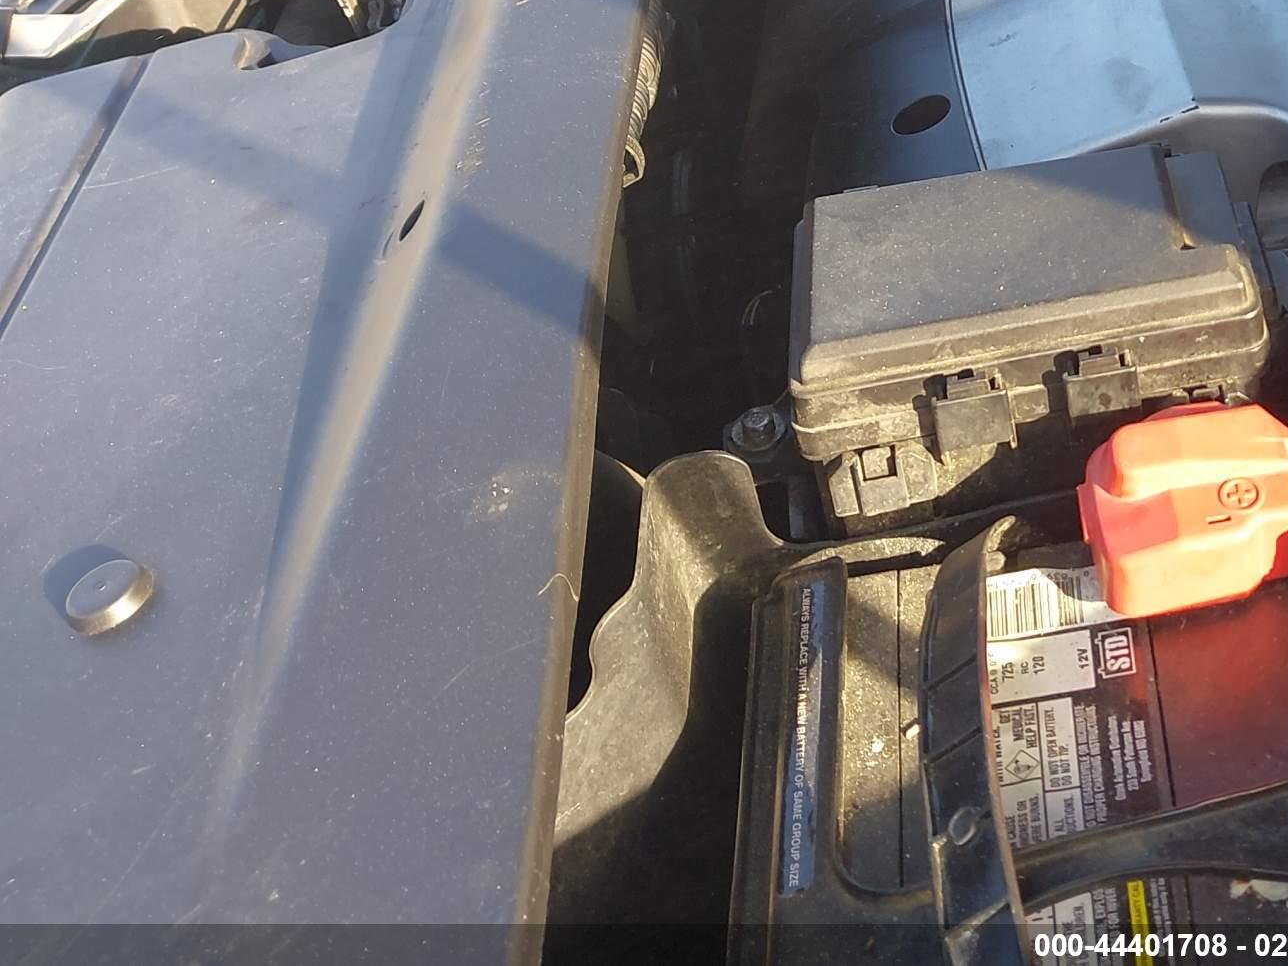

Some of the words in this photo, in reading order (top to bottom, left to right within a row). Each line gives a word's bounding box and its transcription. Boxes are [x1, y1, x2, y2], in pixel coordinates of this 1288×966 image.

[801, 588, 811, 622] ALWAYS
[800, 623, 809, 665] REPLACE
[1104, 635, 1131, 671] STD
[1021, 661, 1029, 674] RC
[1032, 656, 1045, 674] 120
[1076, 648, 1089, 669] 12V
[798, 666, 808, 692] WITH
[1001, 662, 1014, 682] 725
[990, 677, 998, 694] CCA
[797, 702, 807, 724] NEW
[1024, 706, 1036, 725] FAST.
[1044, 707, 1056, 738] BATTERY.
[1012, 708, 1024, 742] MEDICAL
[1025, 728, 1037, 748] HELP
[1047, 739, 1057, 757] OPEN
[796, 726, 806, 771] BATTERY
[1059, 744, 1069, 756] TIP.
[1048, 760, 1059, 775] NOT
[1060, 759, 1070, 774] NOT
[794, 774, 804, 788] OF
[1050, 778, 1060, 787] DO
[1061, 776, 1072, 786] DO
[792, 791, 803, 821] SAME
[1054, 818, 1064, 832] ALL
[791, 823, 801, 860] GROUP
[789, 863, 800, 887] SIZE
